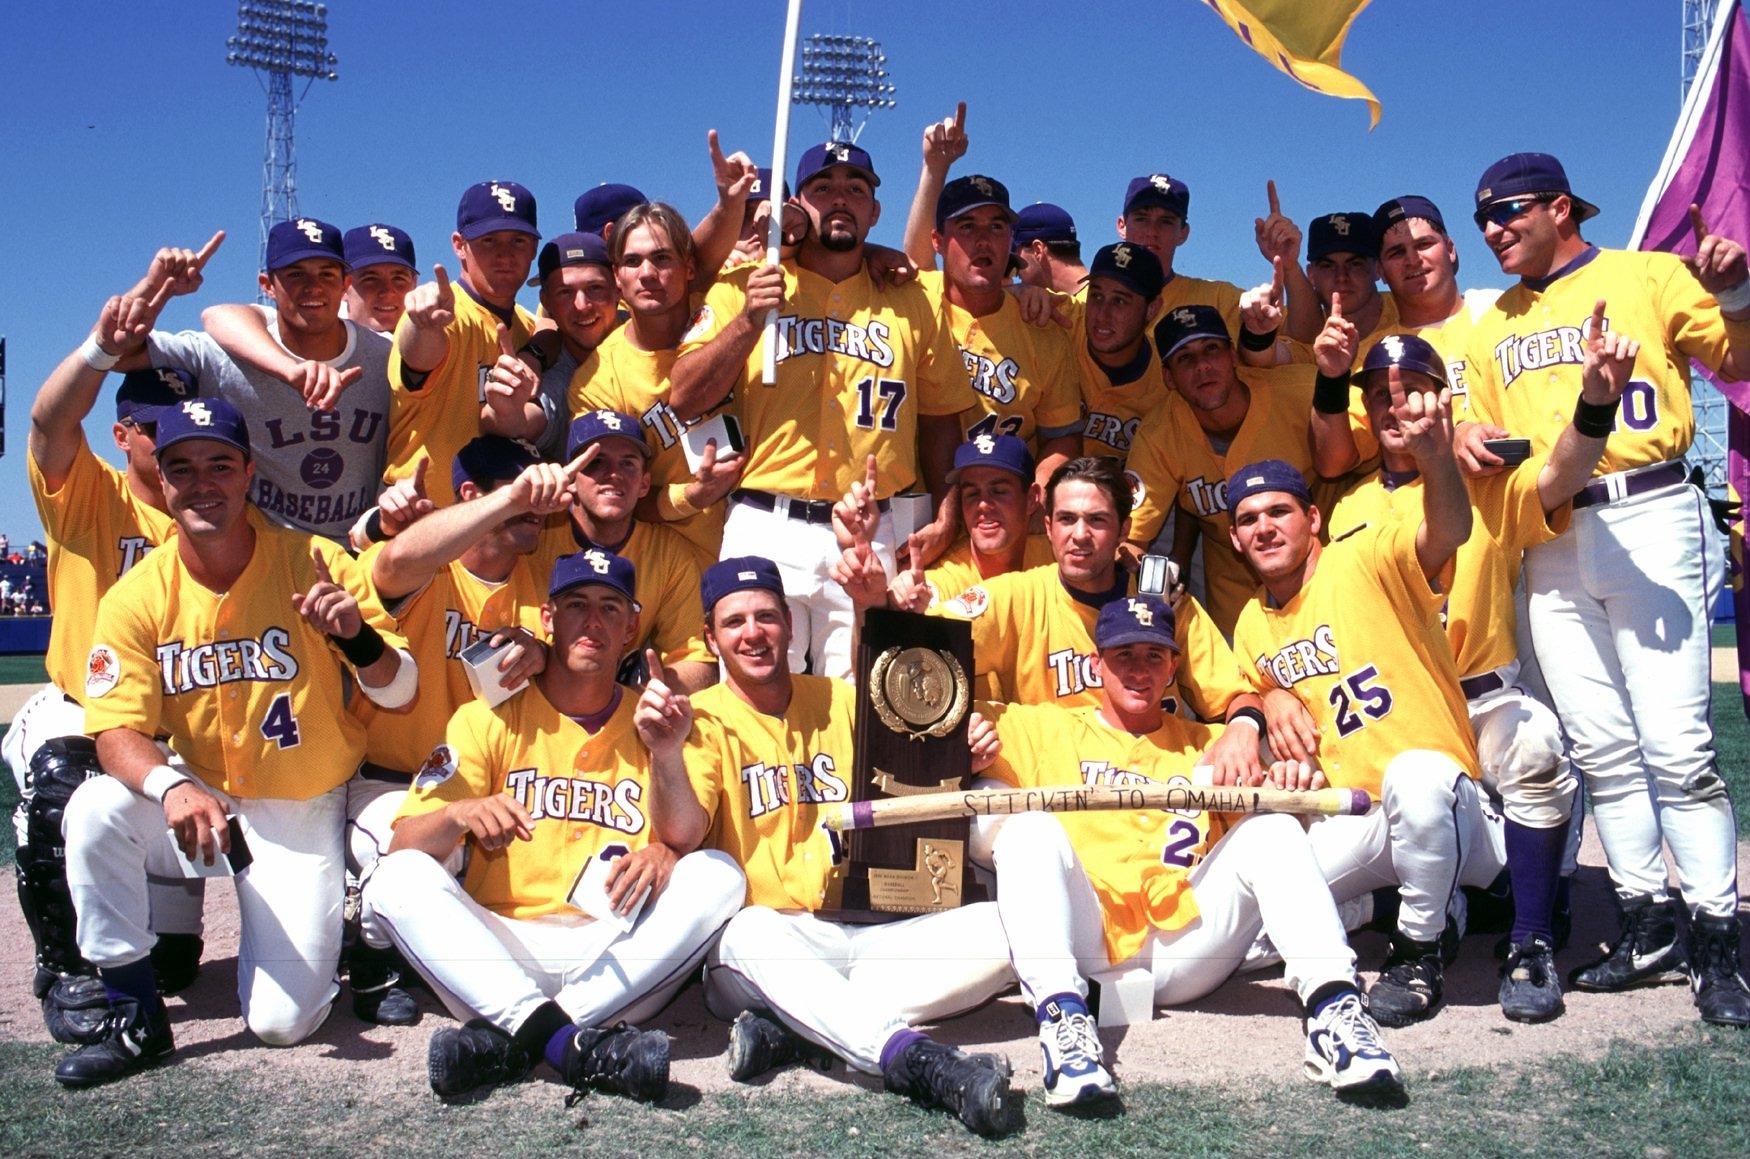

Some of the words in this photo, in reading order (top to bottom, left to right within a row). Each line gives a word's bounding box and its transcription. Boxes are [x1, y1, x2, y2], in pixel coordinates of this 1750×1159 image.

[775, 315, 894, 368] TIGERS
[960, 349, 1019, 404] ERS
[265, 408, 383, 449] LSU
[855, 375, 907, 433] 17
[1081, 411, 1142, 451] ERS
[1611, 377, 1660, 432] 0
[312, 462, 331, 474] 24
[257, 479, 372, 524] BASEBALL
[156, 625, 300, 697] TIGERS
[258, 691, 301, 750] 4
[1327, 662, 1394, 739] 25
[506, 767, 646, 835] TIGERS
[1111, 788, 1145, 810] TO
[1161, 819, 1201, 868] 2
